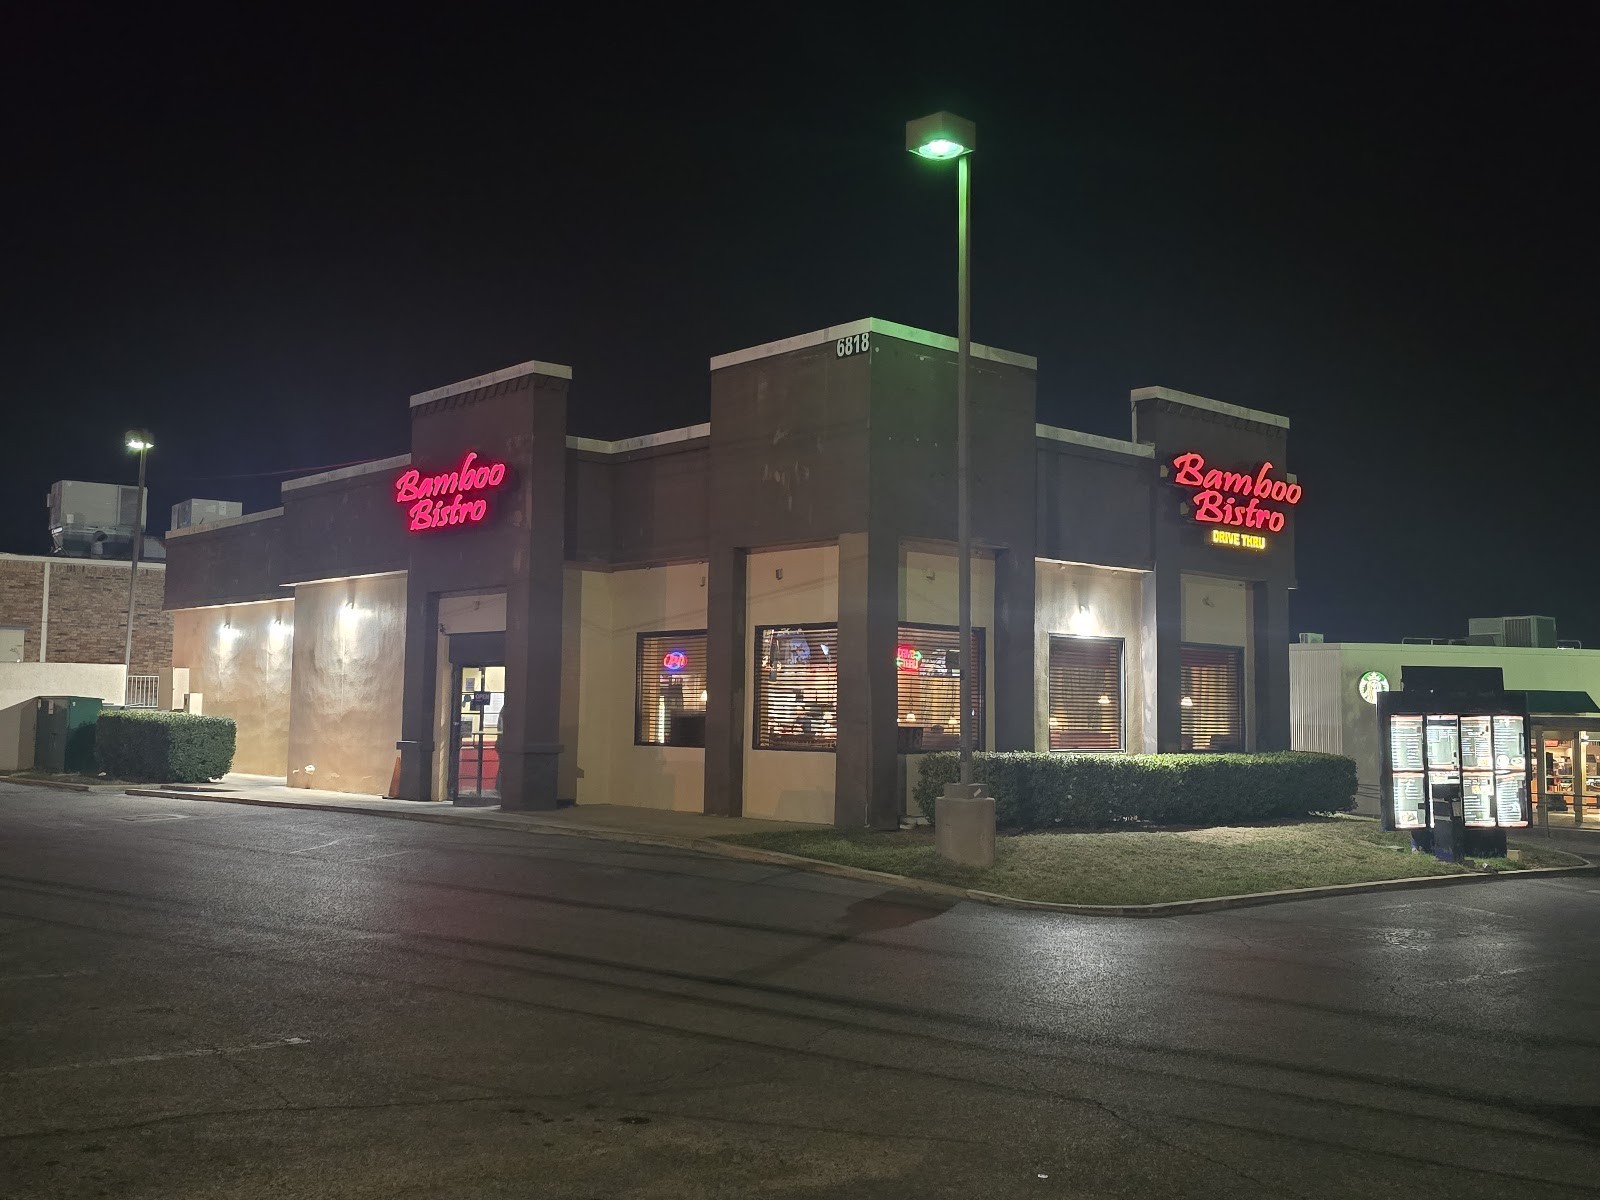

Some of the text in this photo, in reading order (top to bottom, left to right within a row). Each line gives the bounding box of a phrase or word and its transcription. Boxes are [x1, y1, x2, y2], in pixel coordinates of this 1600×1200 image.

[836, 333, 869, 357] 6818
[396, 452, 505, 502] Bamboo
[1173, 453, 1302, 504] Bamboo
[410, 494, 487, 530] Bistro
[1193, 490, 1285, 532] Bistro
[1212, 530, 1265, 549] DRIVE THRU
